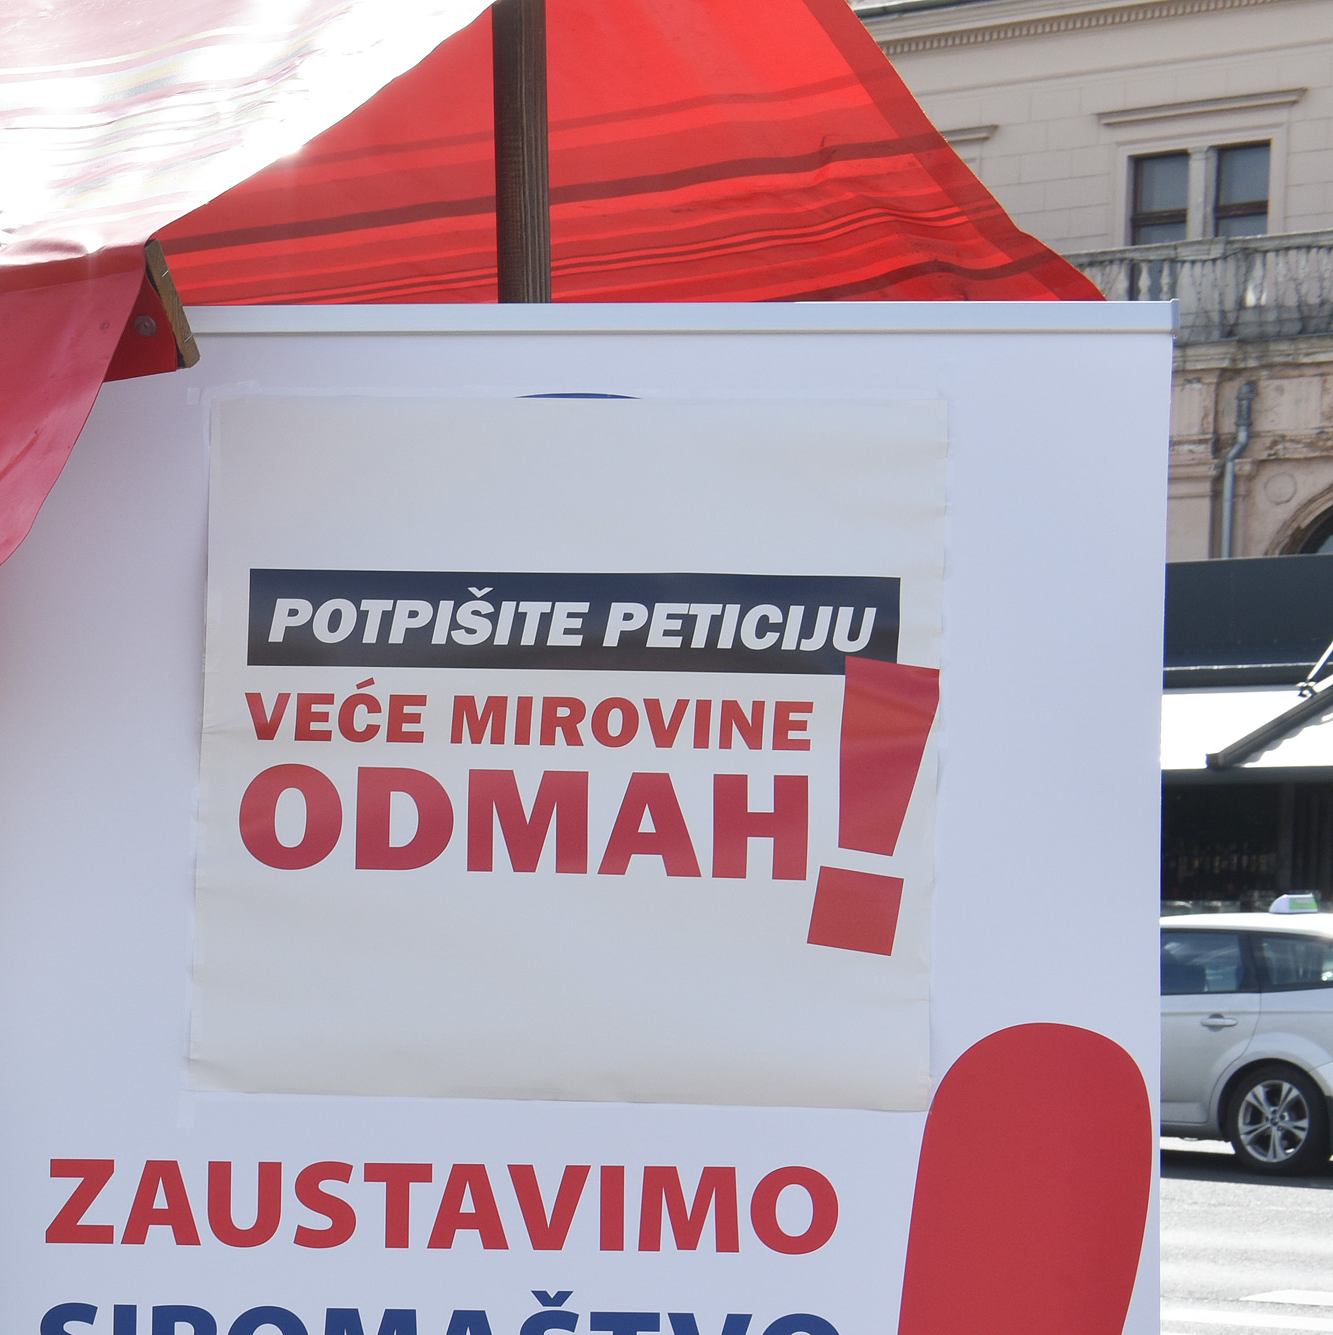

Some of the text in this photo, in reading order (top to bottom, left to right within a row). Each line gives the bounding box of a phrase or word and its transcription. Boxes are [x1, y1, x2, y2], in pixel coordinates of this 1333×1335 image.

[268, 586, 877, 653] POTPIŠITE PETICIJU
[244, 677, 814, 752] VEĆE MIROVINE
[238, 655, 940, 956] ODMAH!
[45, 1158, 839, 1255] ZAUSTAVIMO
